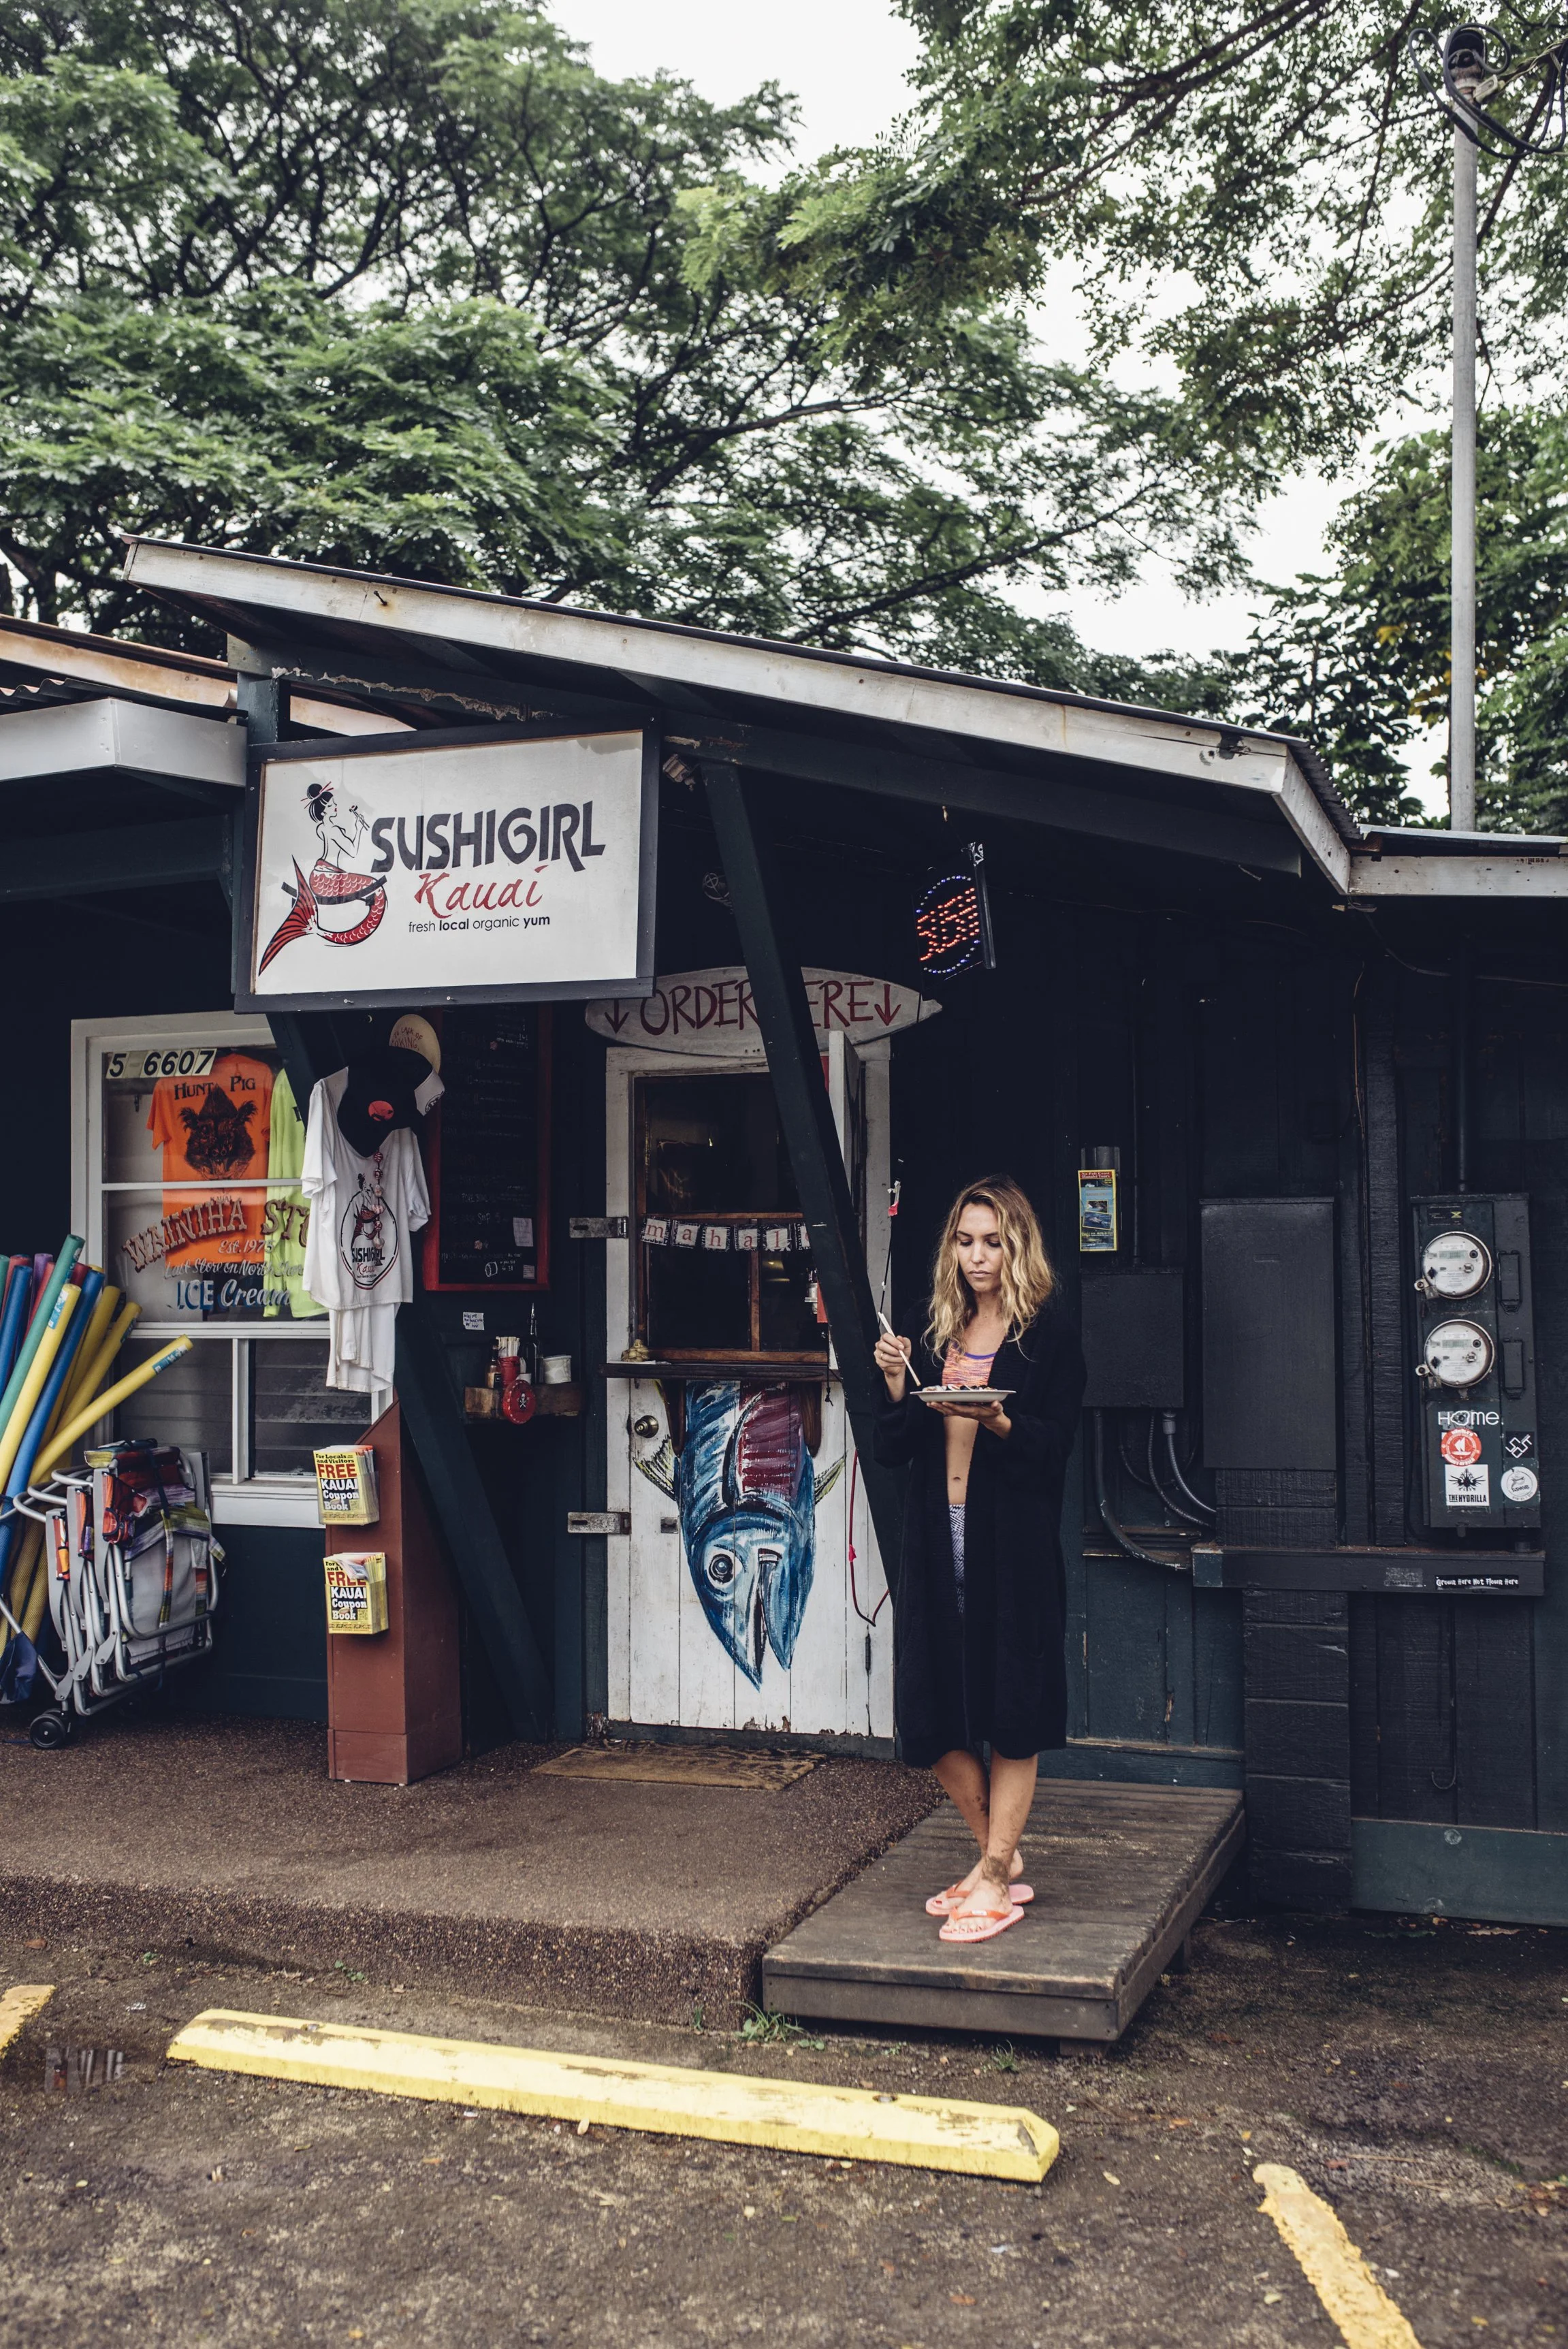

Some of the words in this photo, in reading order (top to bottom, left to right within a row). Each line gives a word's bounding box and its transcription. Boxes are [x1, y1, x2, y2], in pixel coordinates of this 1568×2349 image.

[370, 801, 606, 873] SUSHIGIRL
[414, 864, 548, 918] Kauai
[409, 921, 436, 933] fresh
[438, 919, 469, 931] local
[473, 916, 519, 932] organic
[524, 914, 551, 929] yum
[640, 979, 761, 1036] ORDER
[121, 1198, 248, 1273] WAINIHA
[218, 1239, 242, 1253] Est.
[243, 1239, 274, 1253] 1975
[193, 1258, 223, 1274] Store
[223, 1262, 238, 1274] on
[177, 1279, 214, 1310] ICE
[217, 1278, 291, 1309] Cream
[317, 1464, 357, 1478] FREE
[321, 1478, 359, 1490] KAUAI
[323, 1490, 360, 1499] Coupon
[1458, 1495, 1487, 1503] HYDRILLA
[323, 1498, 349, 1510] Book
[1436, 1578, 1456, 1586] Grown
[1486, 1578, 1503, 1586] Flown
[331, 1586, 367, 1599] KAUAI
[332, 1599, 368, 1608] Coupon
[332, 1607, 356, 1620] Book
